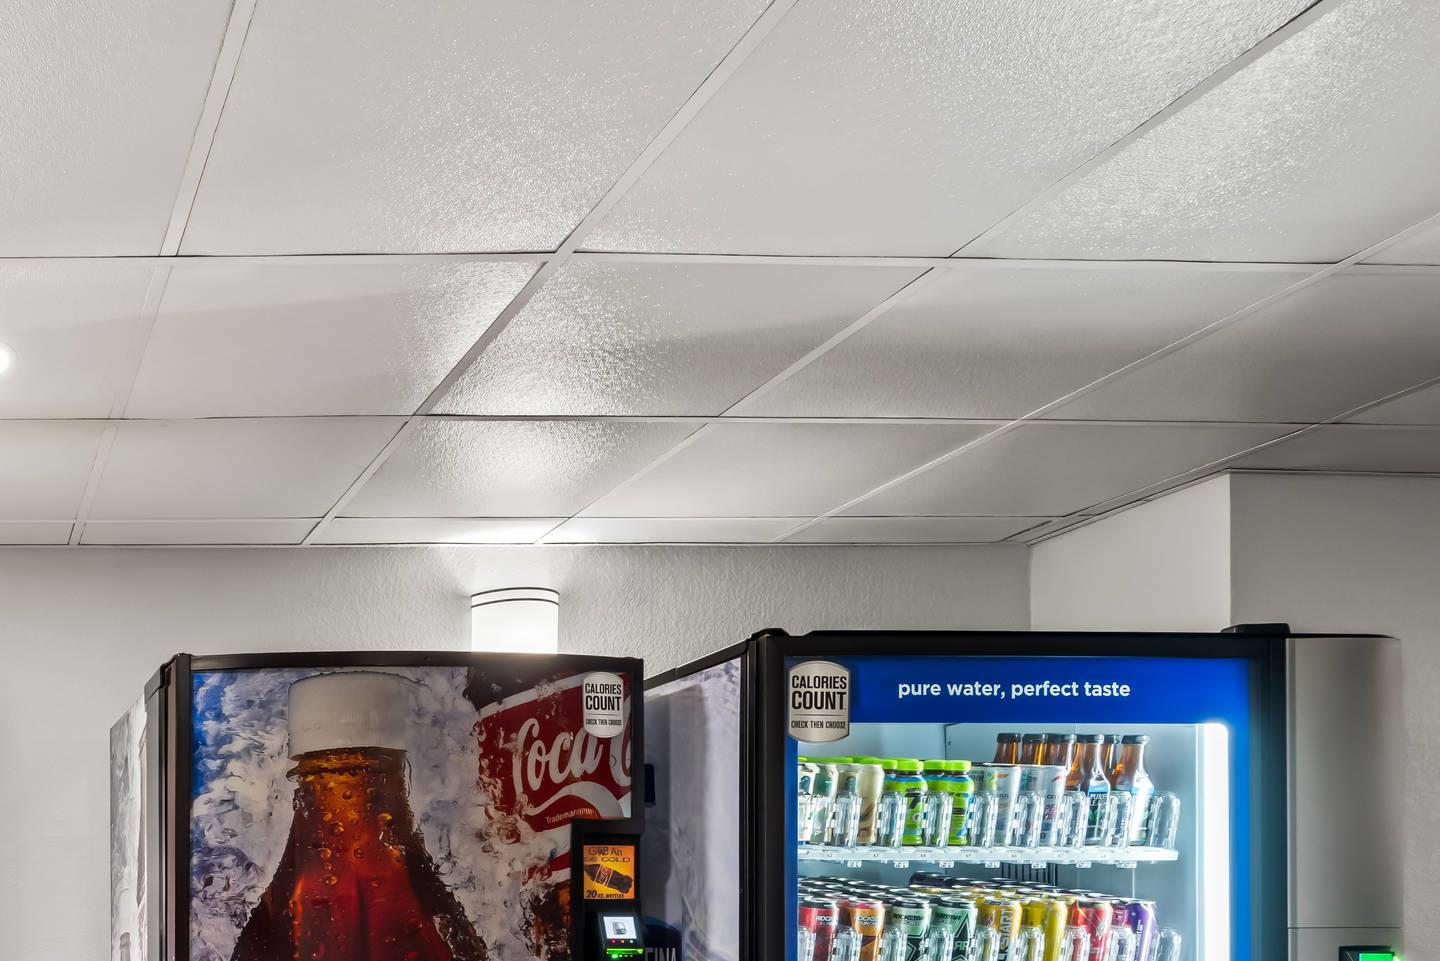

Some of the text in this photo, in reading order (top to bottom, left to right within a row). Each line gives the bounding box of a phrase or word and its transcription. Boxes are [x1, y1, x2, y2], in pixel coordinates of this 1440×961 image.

[792, 675, 847, 689] CALORIES
[584, 683, 622, 695] CALORIES
[898, 680, 1131, 699] pure water, perfect taste
[585, 696, 622, 711] COUNT
[791, 690, 847, 710] COUNT
[791, 720, 847, 729] CHECK THEN CHOOSE
[611, 848, 622, 857] An
[586, 889, 598, 898] 20
